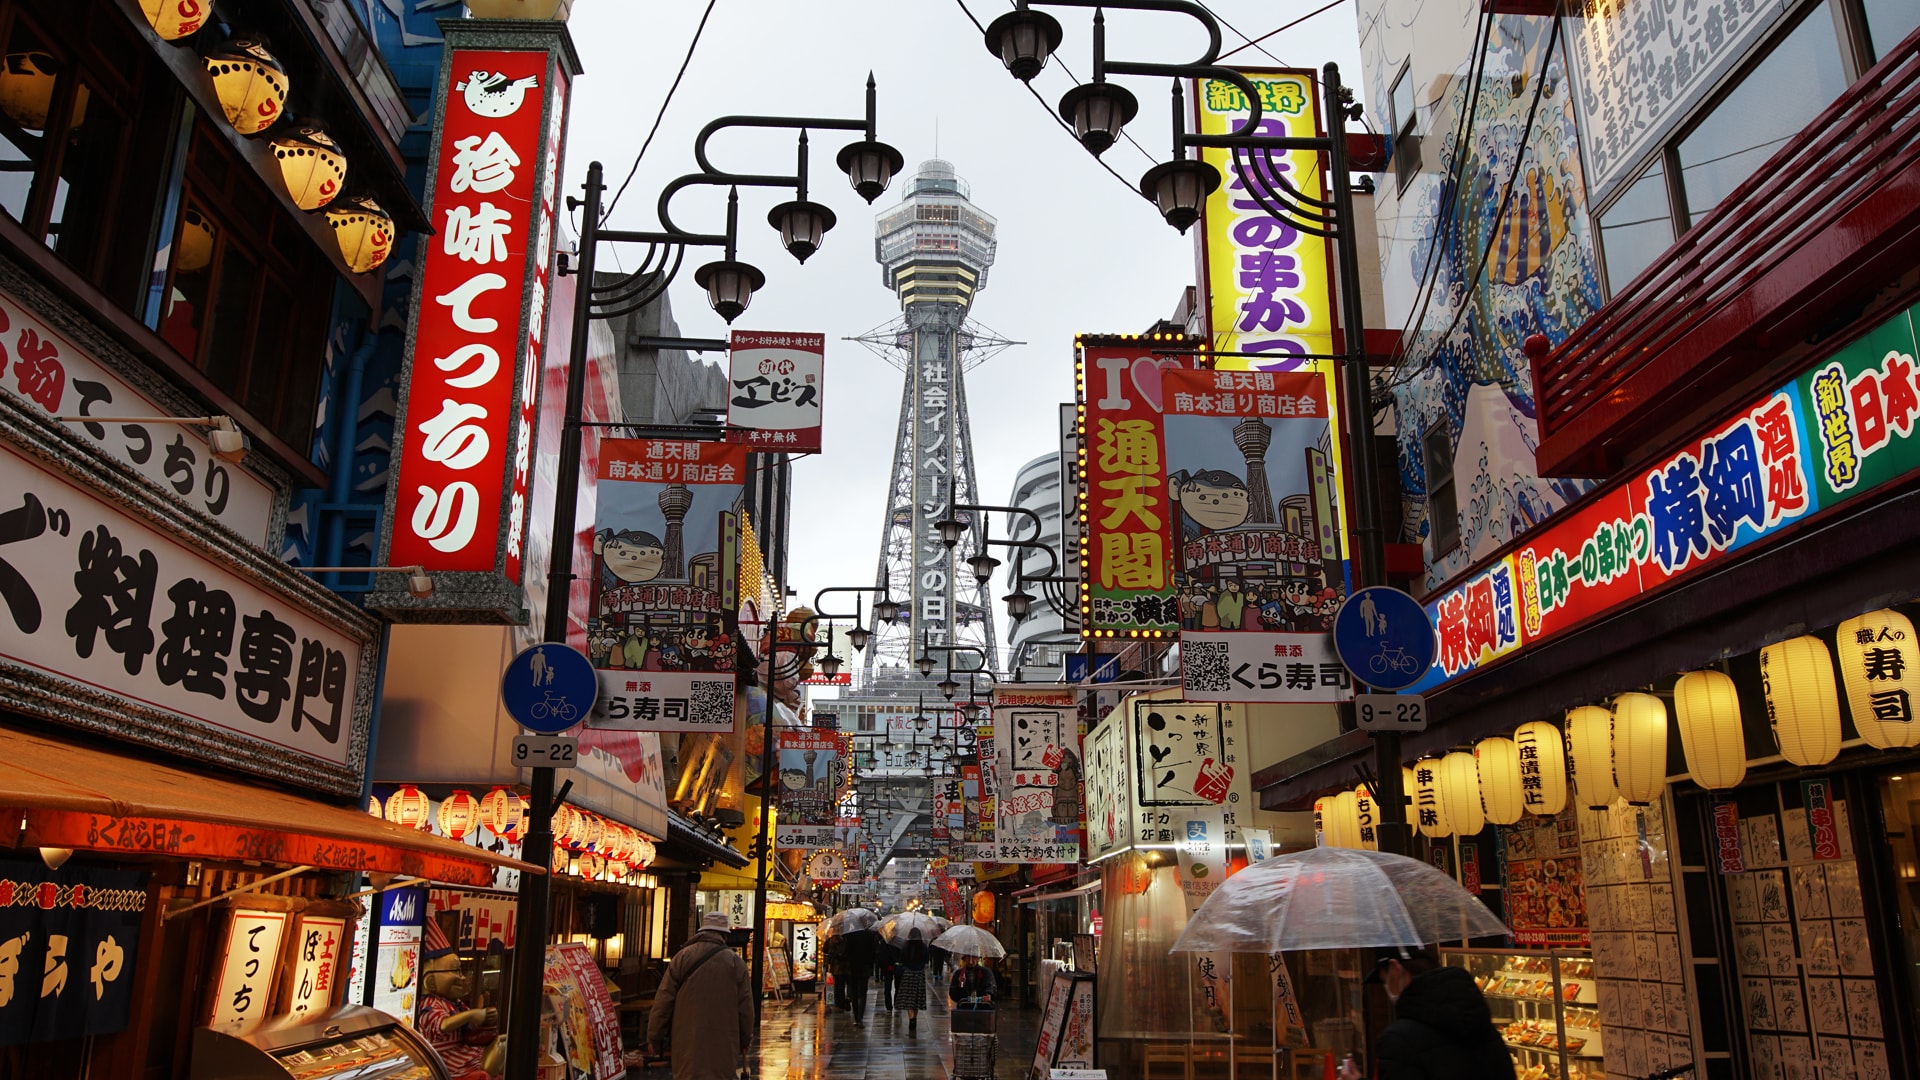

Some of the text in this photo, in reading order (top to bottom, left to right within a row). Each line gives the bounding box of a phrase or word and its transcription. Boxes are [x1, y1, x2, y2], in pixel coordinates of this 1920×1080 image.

[1620, 29, 1646, 130] にんにく
[1633, 10, 1660, 118] 玉ねぎ
[1206, 79, 1304, 114] 新世界
[1597, 62, 1622, 160] うずら玉子
[1608, 41, 1636, 150] 紅しょうが
[1584, 79, 1607, 175] もち
[411, 131, 521, 553] 珍味てっちり
[758, 358, 795, 376] 初代
[1213, 372, 1276, 392] 通天閣
[1173, 393, 1317, 416] 南本通り商店会
[1850, 356, 1920, 452] 日本
[749, 431, 797, 443] 年中無休
[1814, 370, 1857, 484] 新世界
[645, 442, 700, 461] 通天閣
[1754, 399, 1804, 521] 酒処
[608, 460, 736, 482] 南本通り商店会
[1097, 417, 1164, 590] 通天閣
[1648, 422, 1765, 571] 横綱
[1185, 535, 1321, 562] 南本通り商店街
[1537, 518, 1650, 613] 日本一の串かつ
[603, 586, 721, 610] 南本通り商店街
[1093, 598, 1132, 610] 日本一の
[1492, 566, 1516, 648] 酒処
[1521, 550, 1541, 635] 新世界
[1093, 610, 1132, 624] 串かつ
[1437, 574, 1497, 674] 横綱
[1273, 643, 1304, 657] 無添
[1856, 626, 1905, 644] 職人の
[625, 681, 652, 693] 無添
[1230, 662, 1352, 692] くら寿司
[1863, 647, 1913, 722] 寿司
[1518, 730, 1545, 806] 二度漬禁止
[998, 792, 1056, 818] 大阪名物
[1357, 799, 1375, 843] もつ鍋
[777, 834, 817, 845] くら寿司
[1810, 809, 1837, 858] 串かつ
[977, 850, 997, 860] くら
[1000, 845, 1077, 860] 宴会予約受付中
[389, 893, 416, 921] Asahi
[732, 893, 744, 925] 串焼き
[314, 930, 335, 990] 土産
